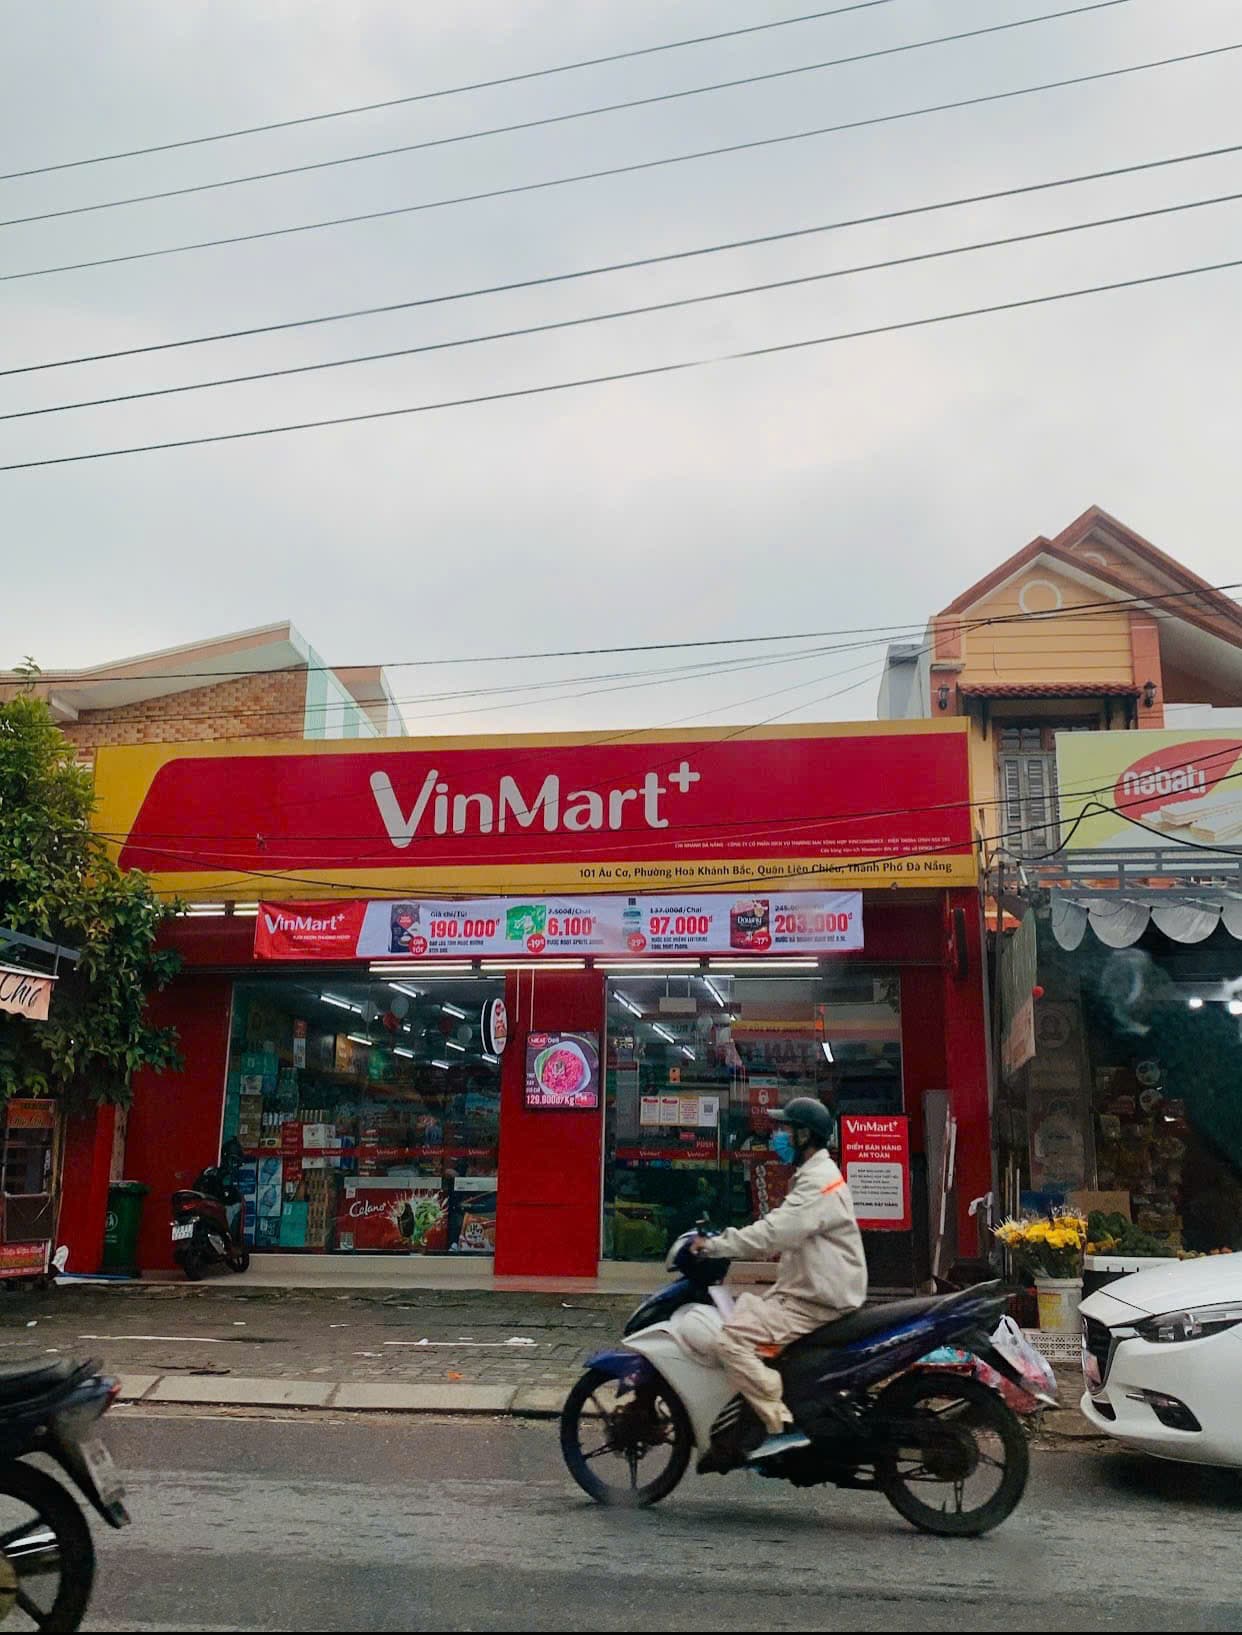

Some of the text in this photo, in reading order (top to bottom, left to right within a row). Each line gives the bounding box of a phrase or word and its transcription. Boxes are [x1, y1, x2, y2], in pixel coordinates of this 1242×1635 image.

[369, 761, 701, 849] VinMart+
[579, 868, 595, 878] 101
[264, 912, 345, 934] VinMart+
[846, 1119, 898, 1133] VinMart+
